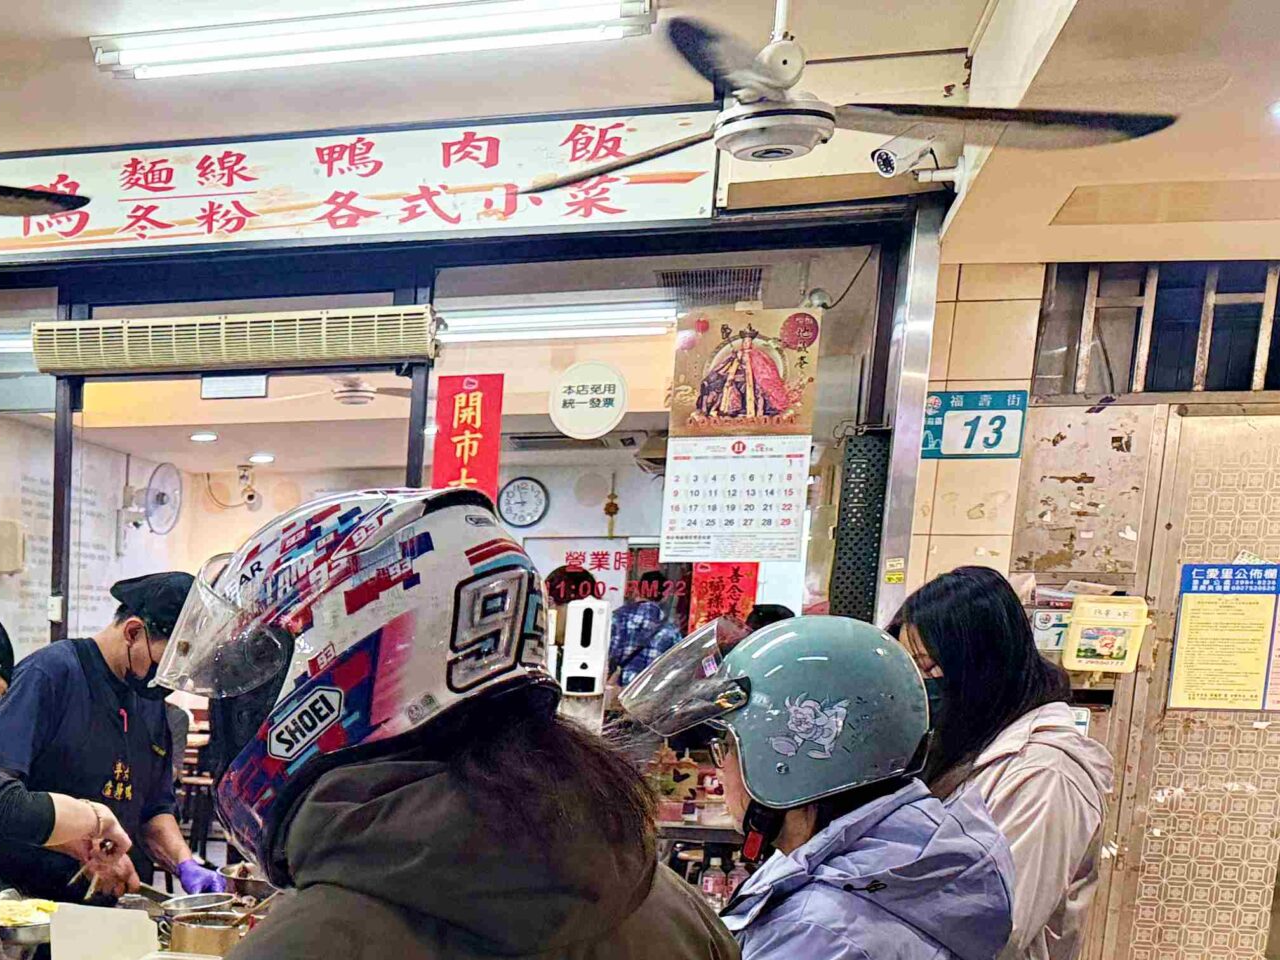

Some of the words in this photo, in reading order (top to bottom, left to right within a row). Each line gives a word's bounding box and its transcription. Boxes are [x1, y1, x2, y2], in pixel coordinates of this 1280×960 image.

[315, 122, 627, 177] 鴨肉飯
[120, 150, 258, 192] 麵線
[120, 199, 258, 240] 冬粉
[314, 175, 627, 232] 各式小菜
[562, 384, 616, 395] 本店免用
[562, 397, 615, 409] 統一發票
[963, 415, 1006, 449] 13
[275, 693, 336, 753] SHOEI
